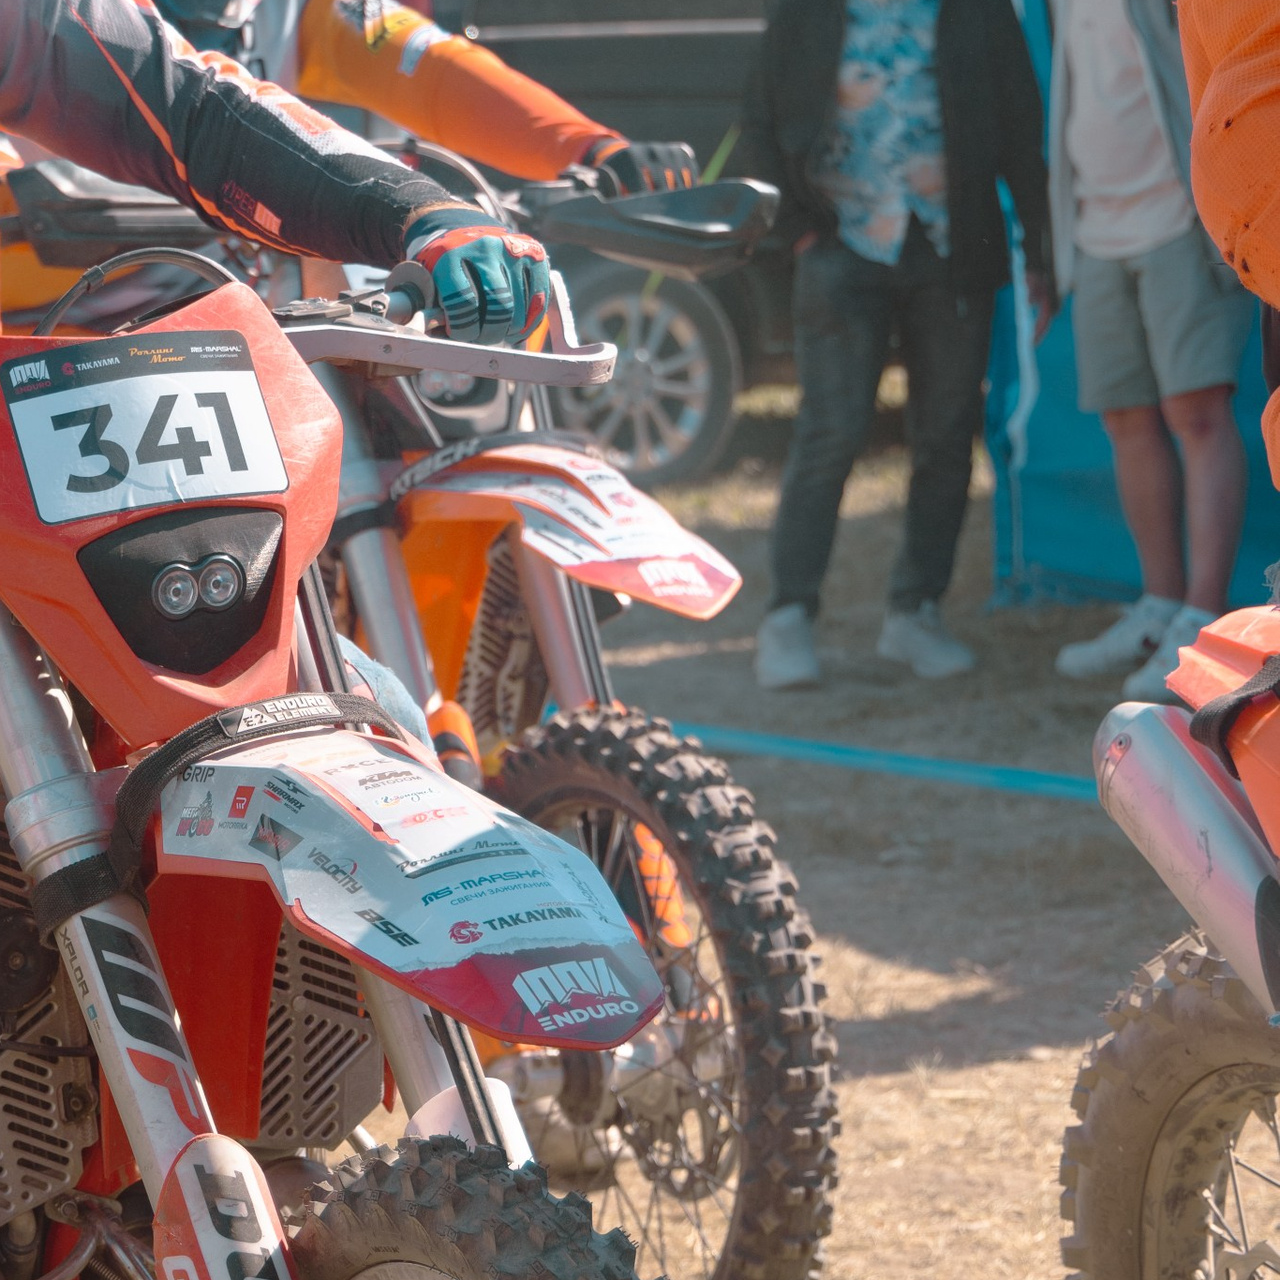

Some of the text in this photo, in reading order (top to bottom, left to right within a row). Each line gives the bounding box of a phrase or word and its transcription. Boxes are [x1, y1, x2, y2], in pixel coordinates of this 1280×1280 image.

[75, 356, 121, 372] TAKAYAMA
[51, 392, 249, 493] 341
[262, 695, 328, 714] ENDURO
[273, 706, 333, 722] ELEMENT
[358, 771, 413, 787] KTM
[307, 847, 363, 895] VELOCITY
[450, 880, 552, 907] СВЕЧИ ЗАЖИГАНИЯ
[483, 906, 588, 931] TAKAYAMA
[59, 926, 90, 1000] XPLOR
[537, 1000, 640, 1032] ENDURO
